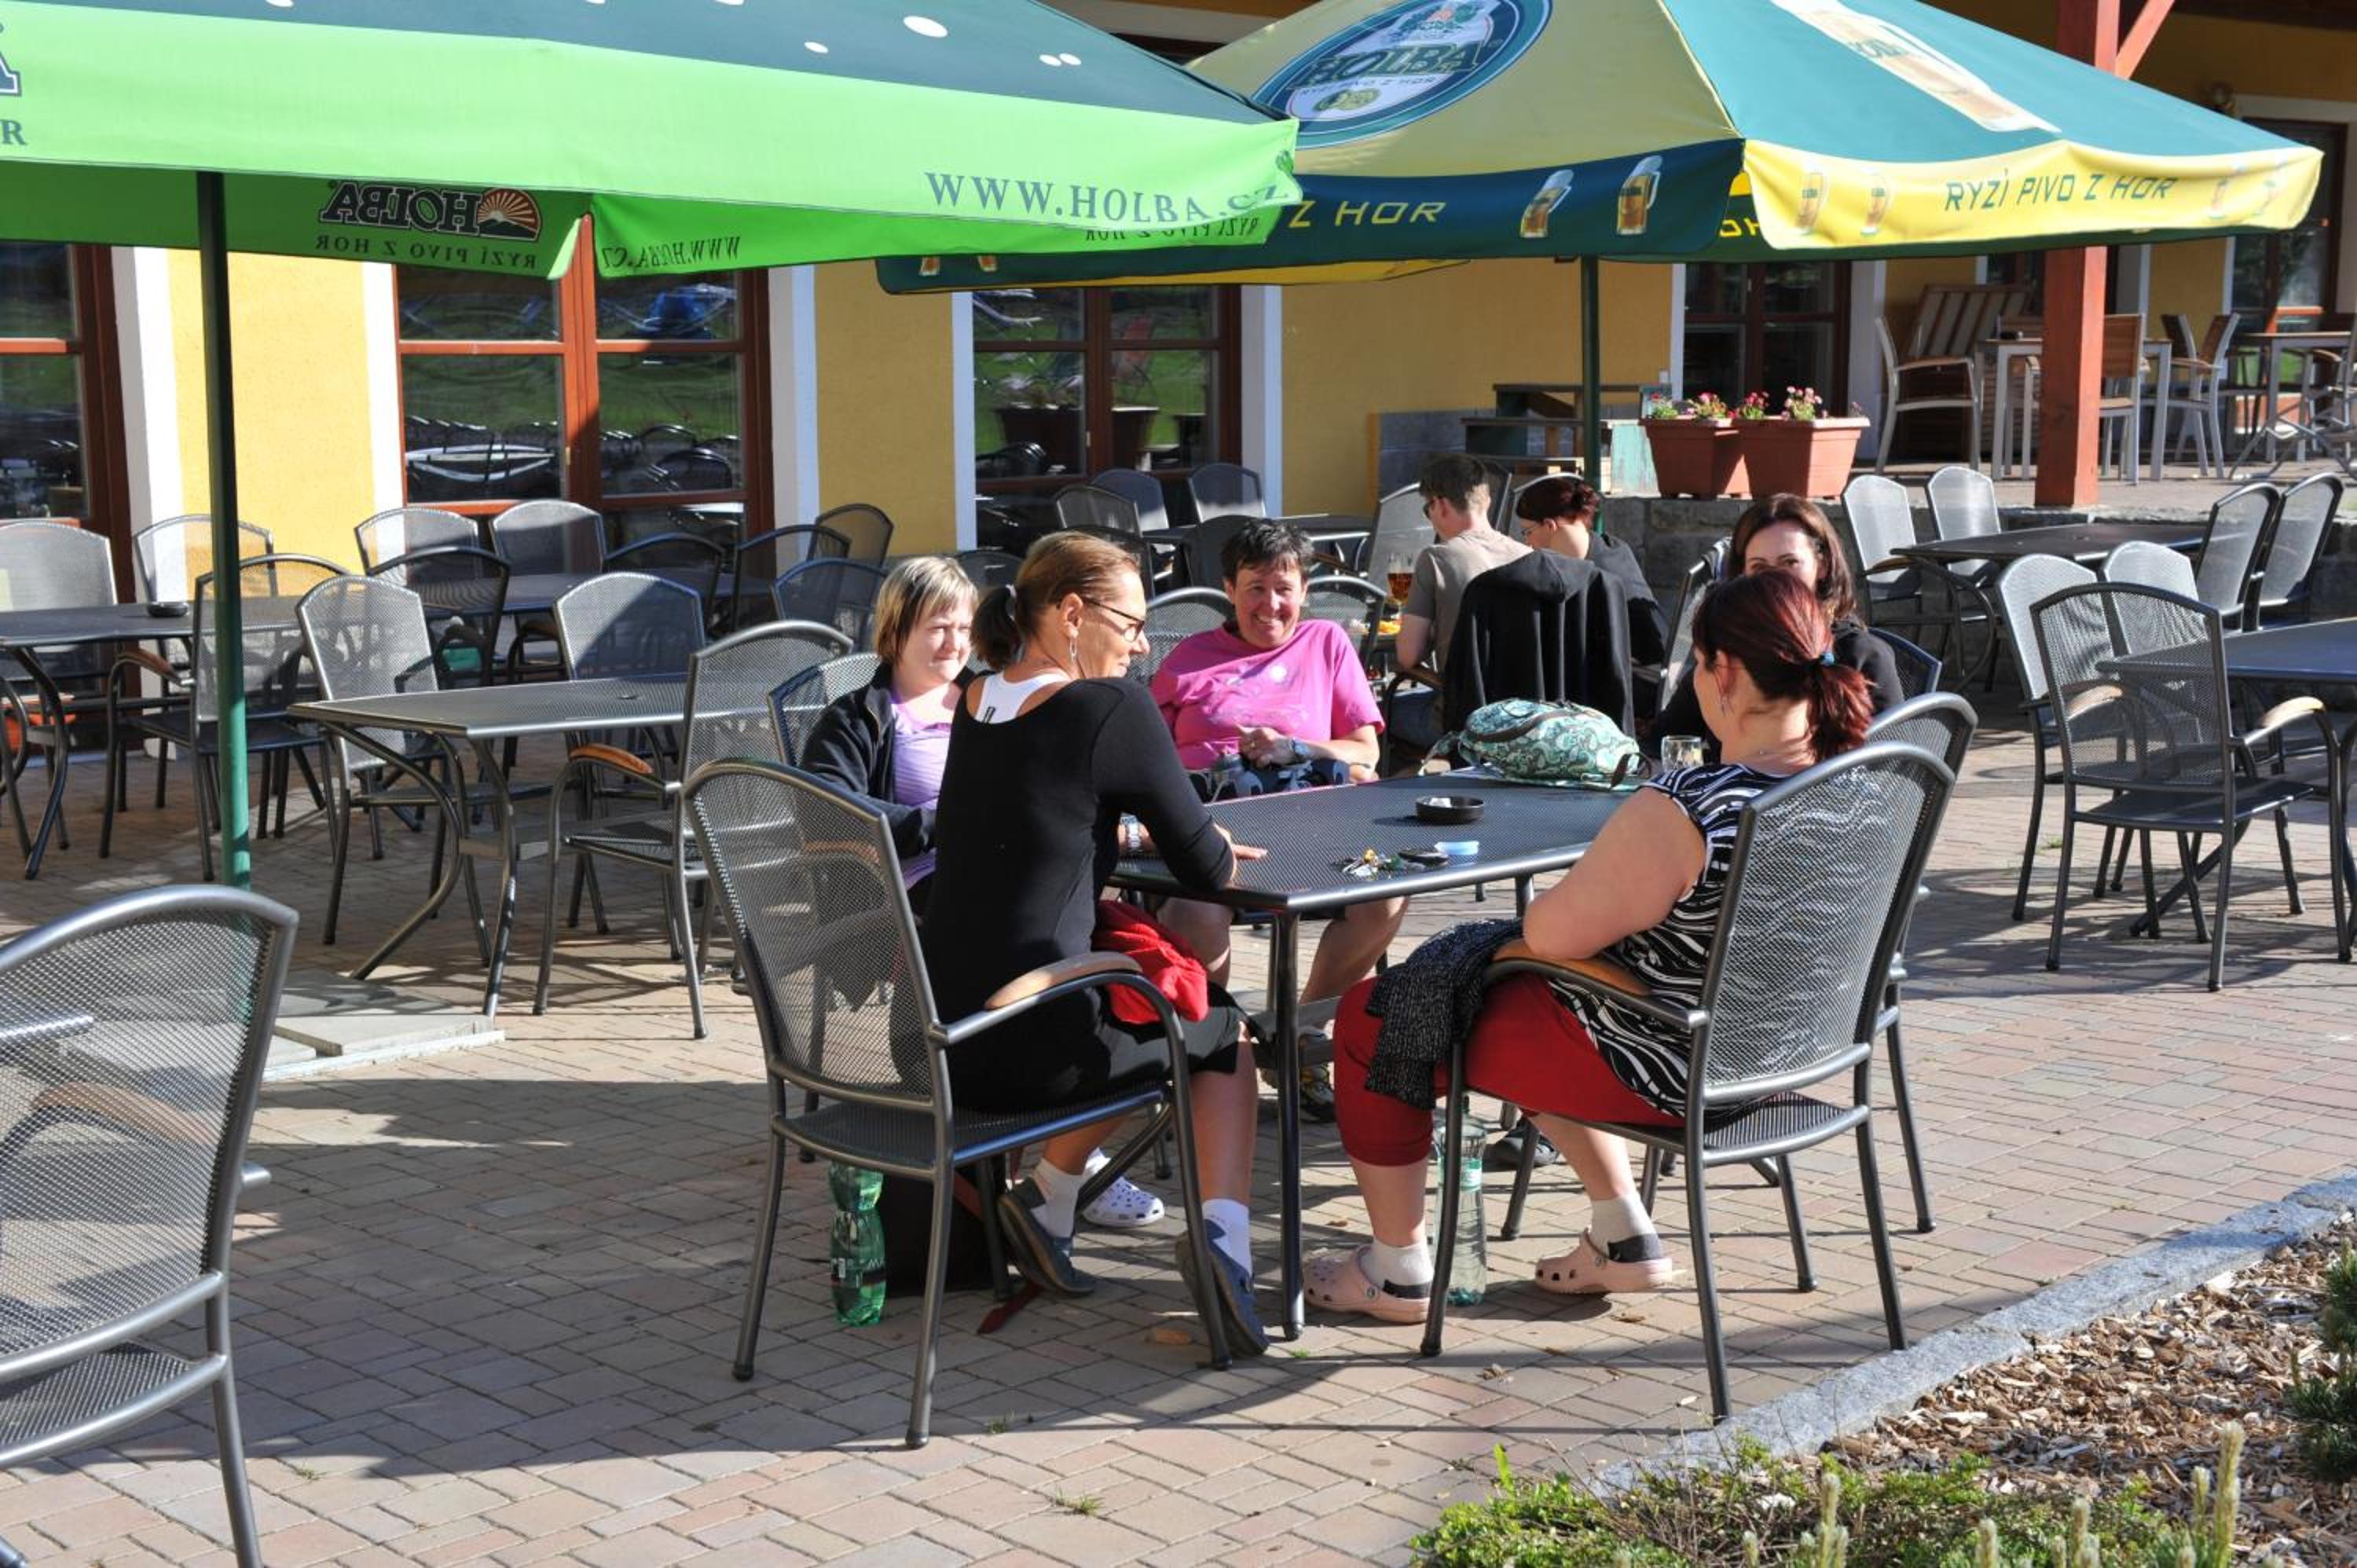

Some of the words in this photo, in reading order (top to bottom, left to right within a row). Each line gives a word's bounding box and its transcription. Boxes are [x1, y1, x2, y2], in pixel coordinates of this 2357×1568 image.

[1286, 42, 1481, 90] HOLBA
[923, 171, 1289, 223] WWW.HOLBA.CZ
[1944, 167, 2010, 211] RYZÍ
[2016, 174, 2077, 206] PIVO
[2084, 173, 2106, 201] Z
[2110, 174, 2180, 200] HOR
[1288, 200, 1317, 229] Z
[1334, 200, 1447, 227] HOR
